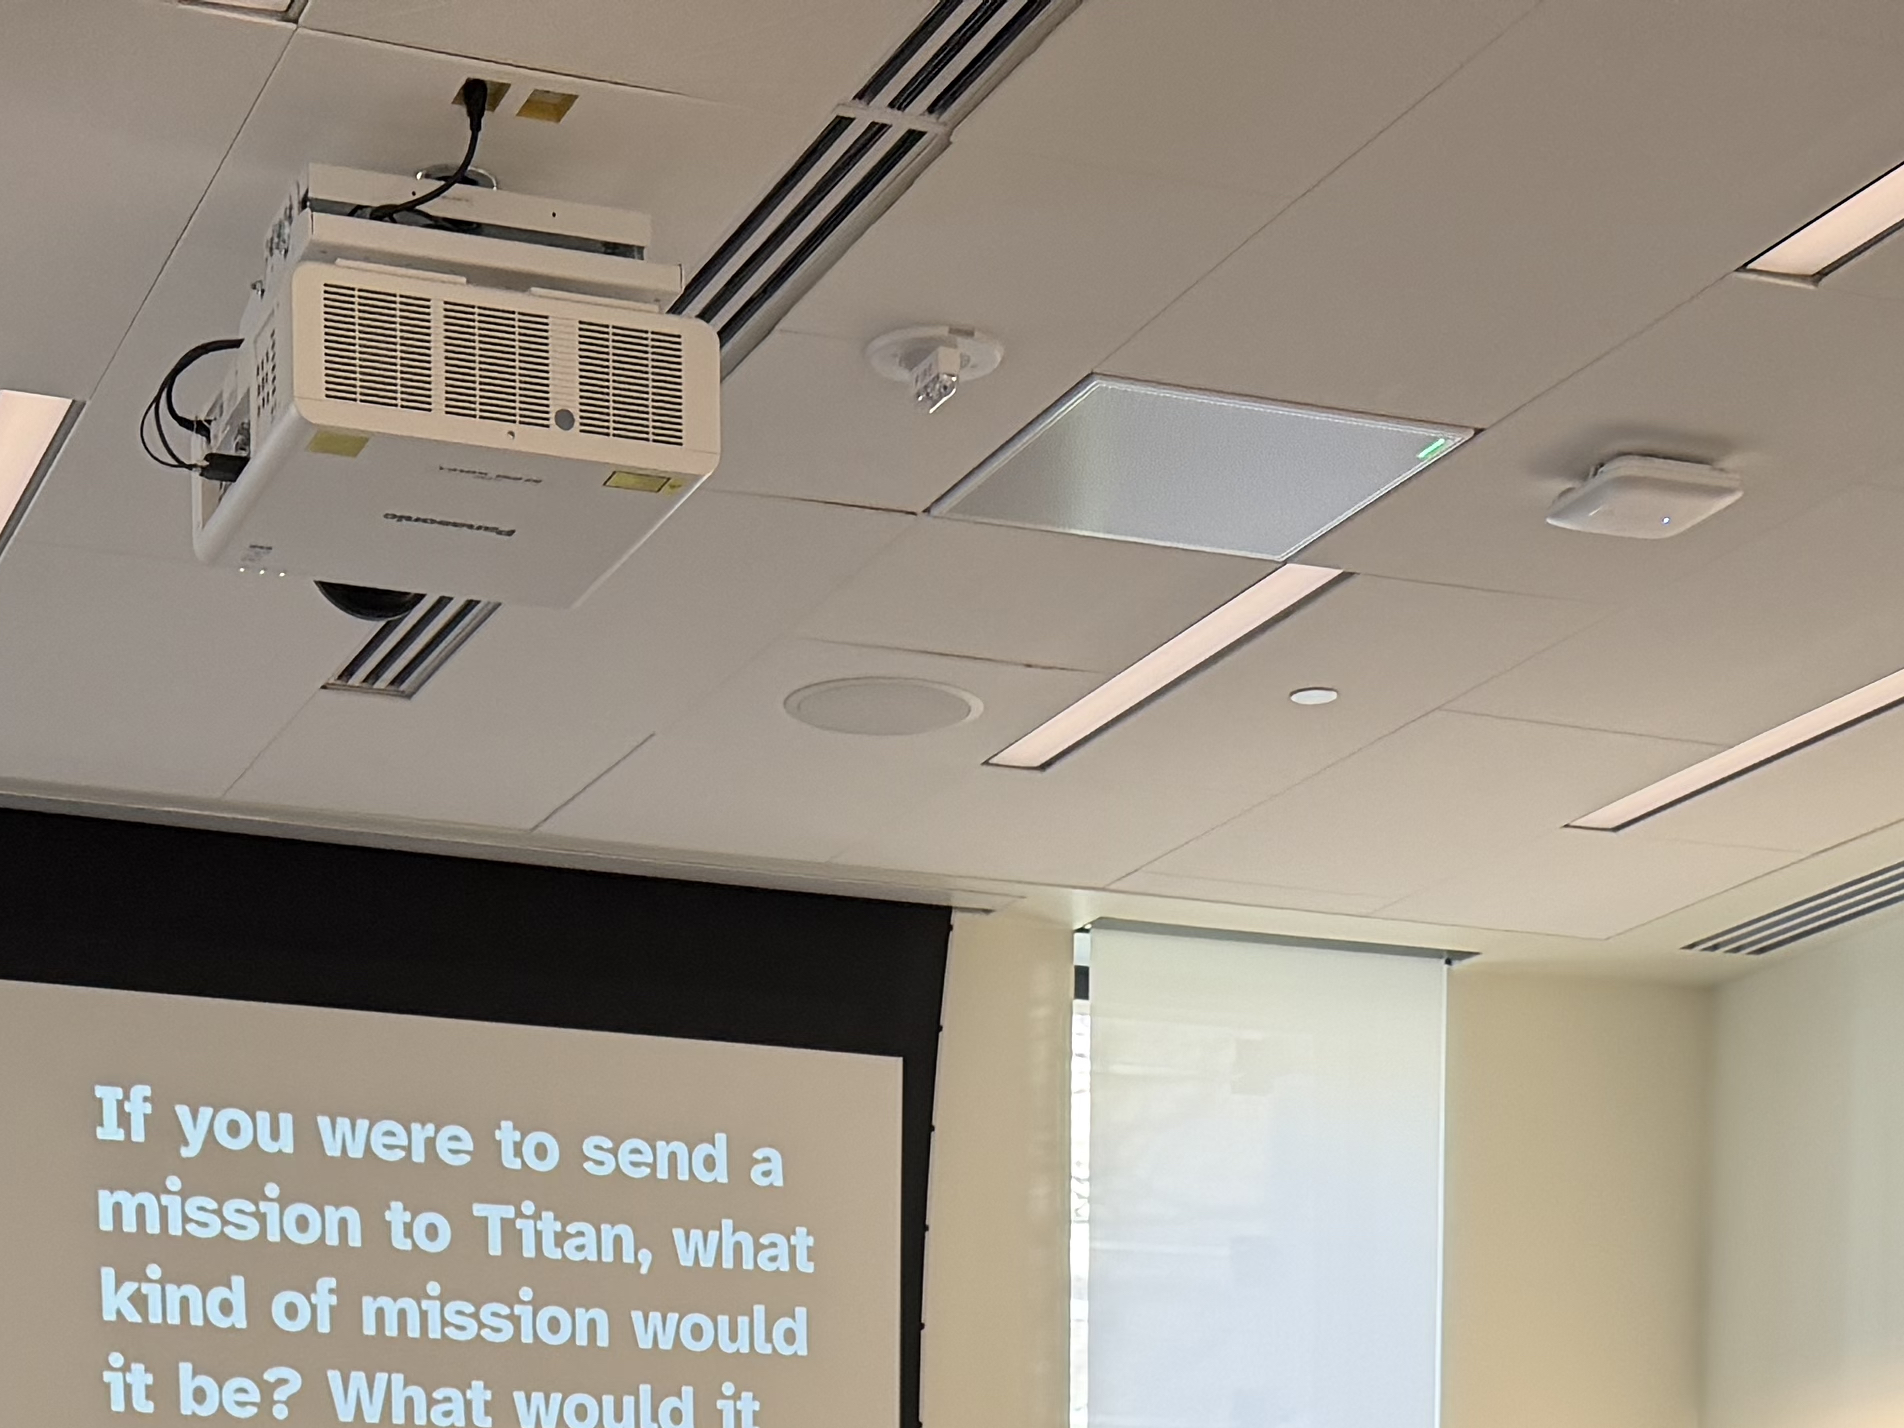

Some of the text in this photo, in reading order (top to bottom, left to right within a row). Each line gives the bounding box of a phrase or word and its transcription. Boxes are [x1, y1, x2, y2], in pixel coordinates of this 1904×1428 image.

[95, 1085, 783, 1186] If you were to send a
[98, 1176, 814, 1274] mission to Titan, what
[101, 1264, 807, 1356] kind of mission would
[103, 1352, 154, 1413] it
[179, 1362, 302, 1420] be?
[327, 1370, 492, 1428] What
